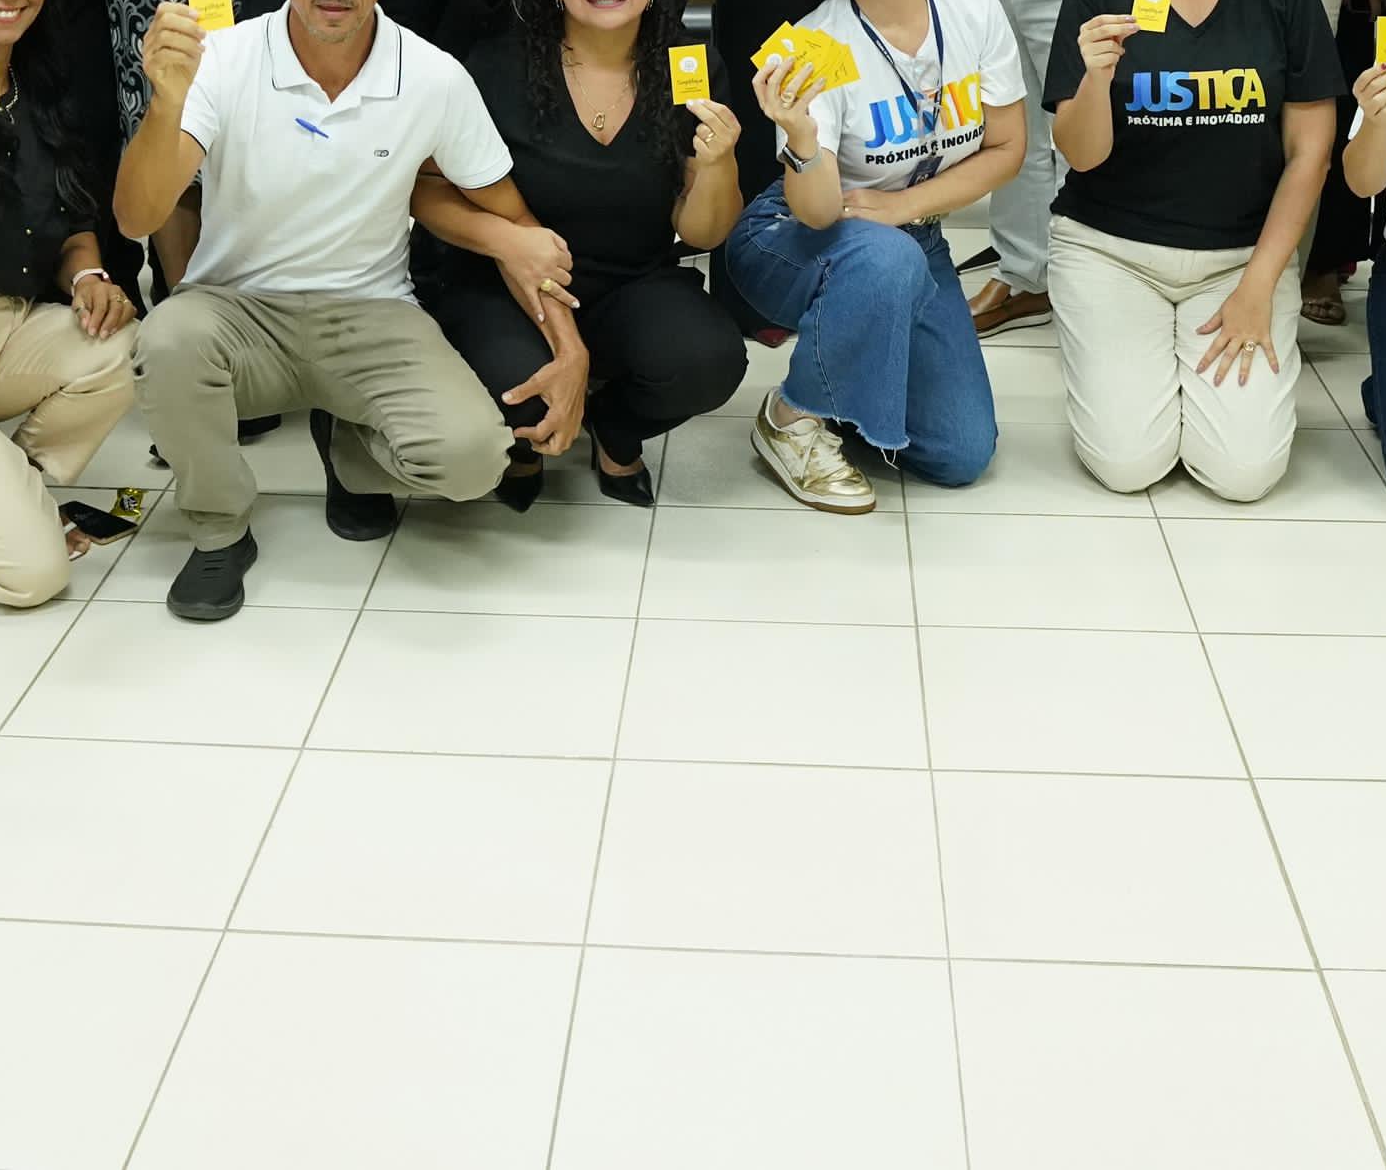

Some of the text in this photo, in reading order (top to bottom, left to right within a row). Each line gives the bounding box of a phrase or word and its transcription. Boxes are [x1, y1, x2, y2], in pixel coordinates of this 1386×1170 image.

[1125, 68, 1267, 113] JUSTIÇA
[1128, 113, 1265, 127] PRÓXIMA E INOVADORA
[865, 141, 928, 165] PRÓXIMA
